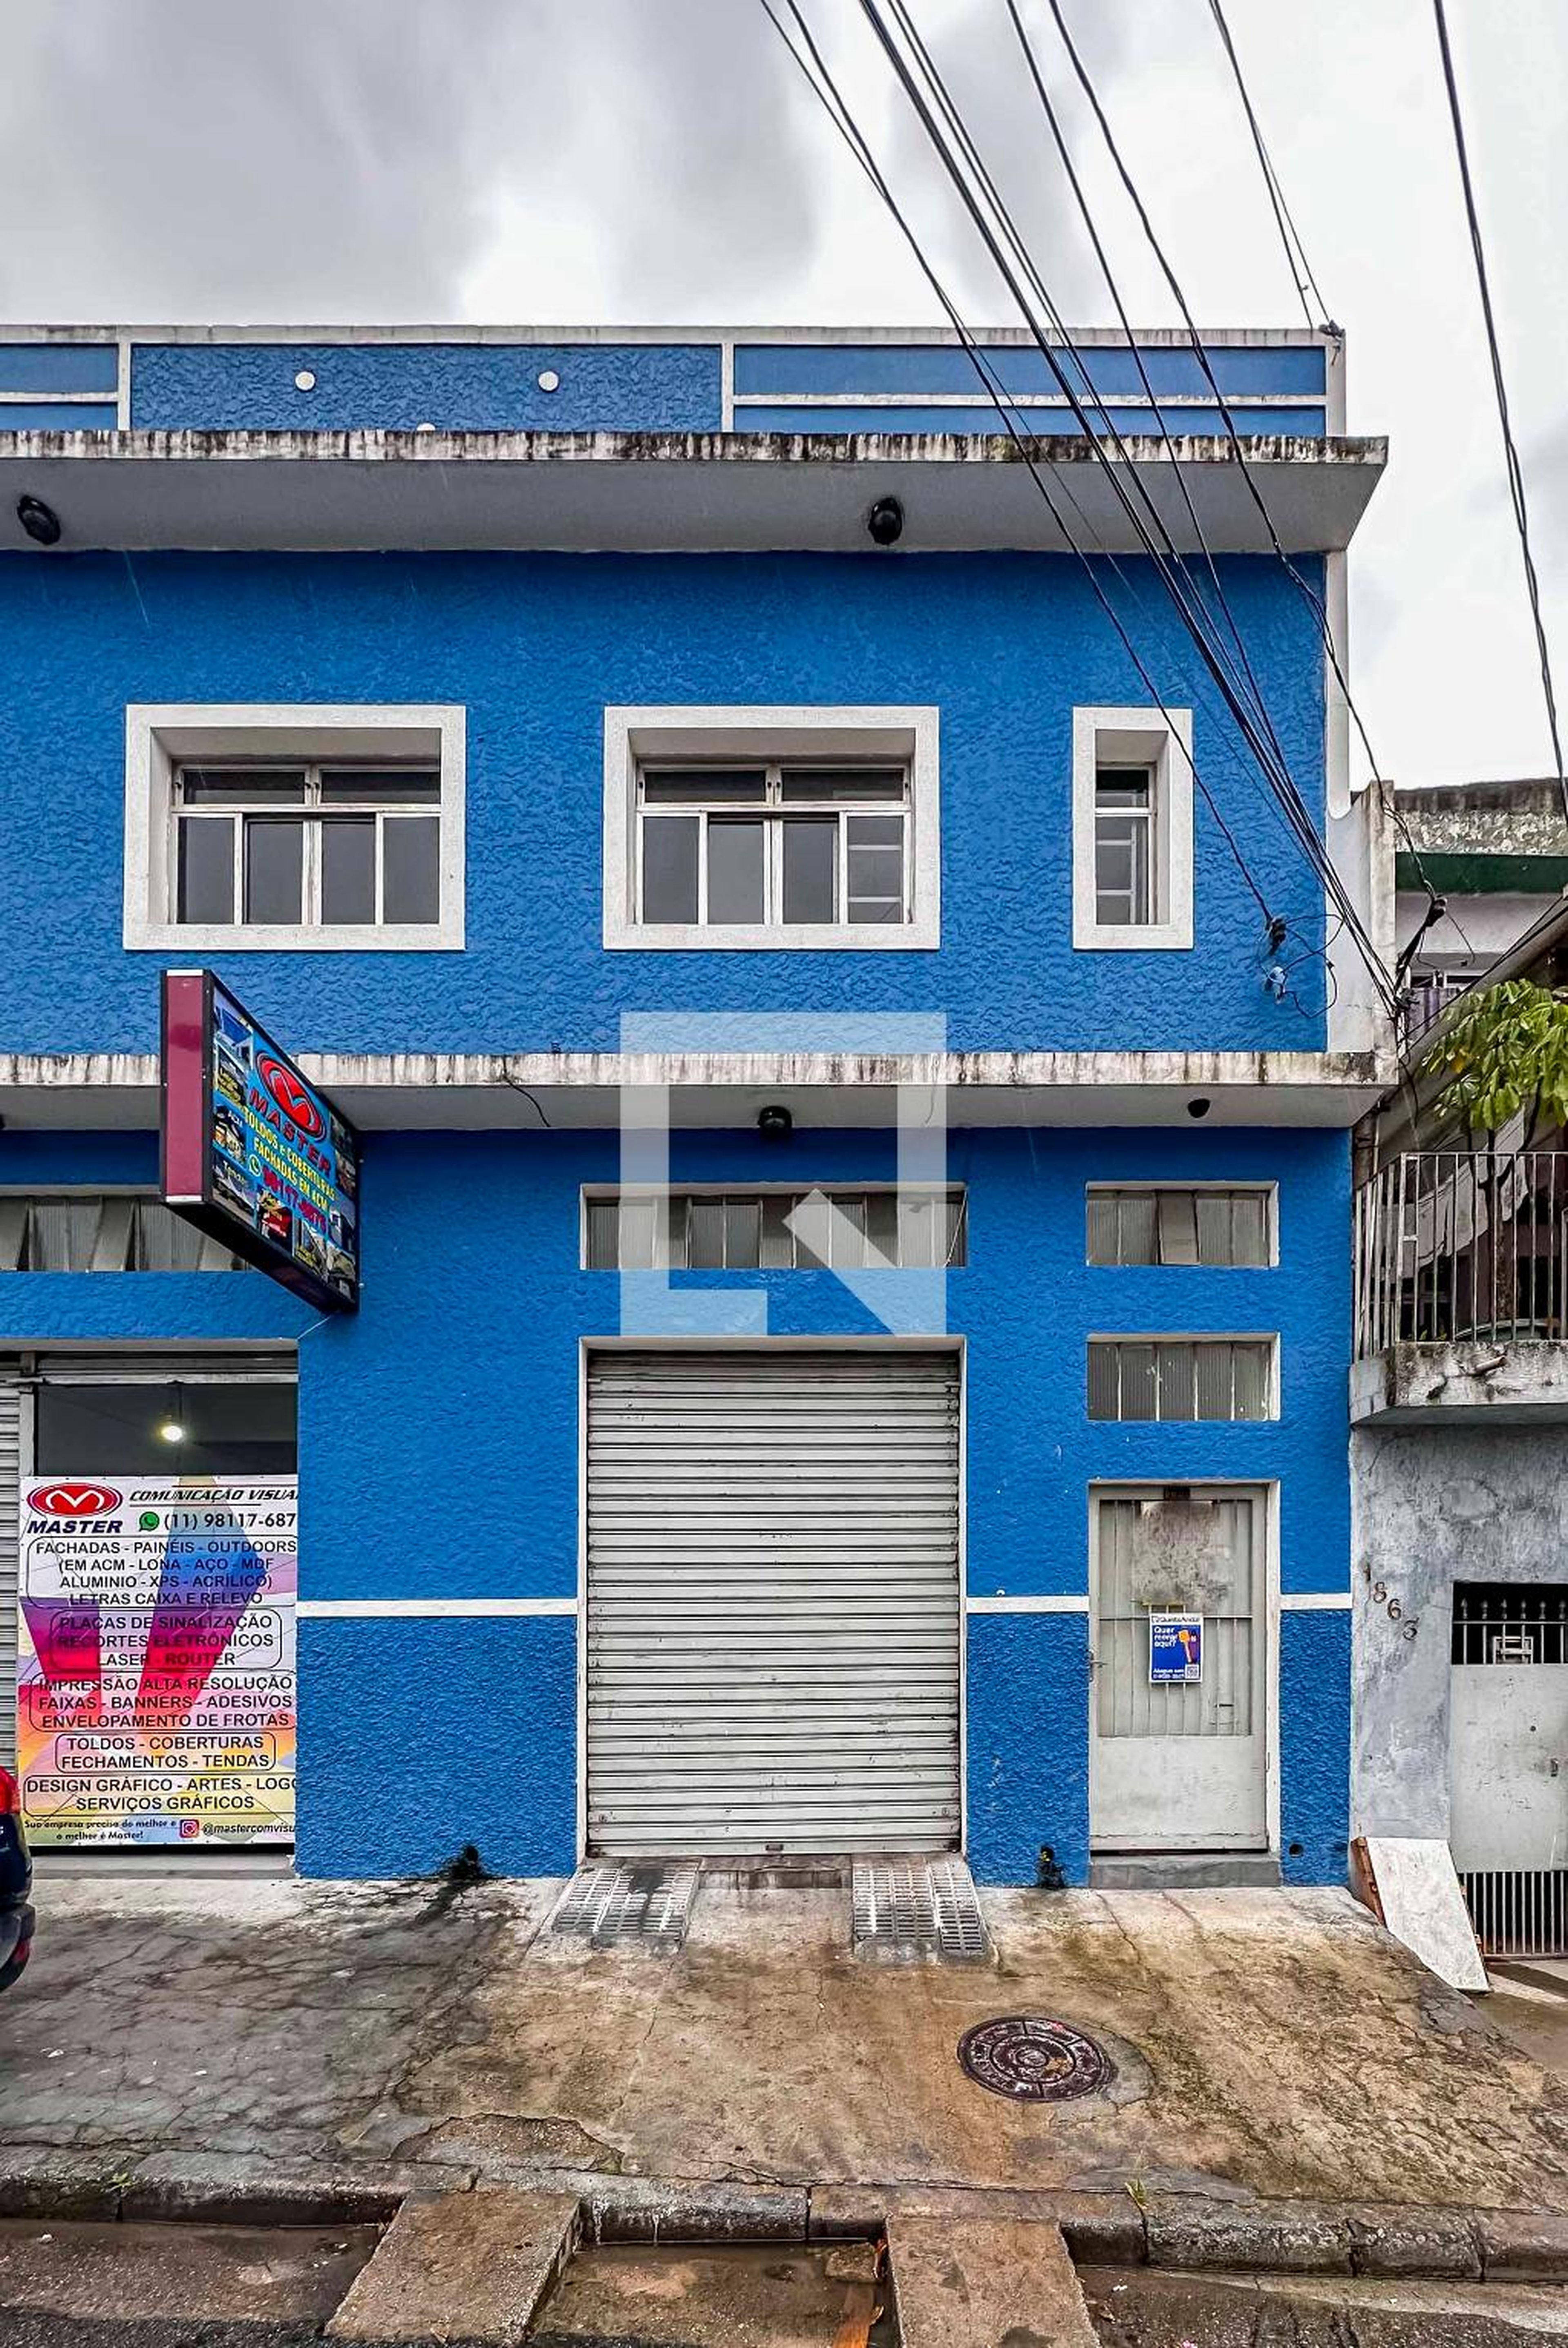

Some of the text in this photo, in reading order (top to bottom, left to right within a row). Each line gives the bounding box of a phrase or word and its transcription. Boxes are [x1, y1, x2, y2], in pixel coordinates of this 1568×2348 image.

[249, 1088, 330, 1176] MASTER
[242, 1104, 278, 1149] TOLDOS
[287, 1147, 335, 1201] COBERTURAS
[254, 1137, 297, 1186] FACHADAS
[129, 1488, 297, 1503] COMUNICAÇÃO VISUA
[27, 1520, 123, 1534] MASTER
[165, 1514, 198, 1530] (11)
[36, 1542, 121, 1554] FACHADAS
[134, 1539, 195, 1553] PAINÉIS
[207, 1541, 297, 1553] OUTDOORS
[59, 1559, 87, 1574] (EM
[91, 1559, 125, 1571] ACM
[139, 1559, 181, 1571] LONA
[194, 1558, 228, 1572] AÇO
[241, 1558, 274, 1570] MDF
[60, 1575, 137, 1588] ALUMINIO
[149, 1575, 180, 1588] XPS
[193, 1574, 272, 1590] ACRÍLICO)
[70, 1592, 263, 1605] LETRAS CAIXA E RELEVO
[60, 1612, 272, 1631] PLACAS DE SINALIZAÇÃO
[58, 1631, 274, 1648] RECORTES ELETRÔNICOS
[98, 1653, 150, 1666] LASER
[165, 1652, 236, 1666] ROUTER
[40, 1674, 292, 1692] IMPRESSÃO ALTA RESOLUÇÃO
[39, 1697, 97, 1710] FAIXAS
[111, 1696, 193, 1709] BANNERS
[206, 1695, 292, 1708] ADESIVOS
[42, 1713, 289, 1728] ENVELOPAMENTO DE FROTAS
[67, 1737, 136, 1750] TOLDOS
[149, 1736, 264, 1749] COBERTURAS
[62, 1755, 188, 1769] FECHAMENTOS
[202, 1755, 270, 1767] TENDAS
[27, 1779, 91, 1793] DESIGN
[96, 1777, 173, 1791] GRÁFICO
[187, 1778, 242, 1791] ARTES
[76, 1793, 255, 1812] SERVIÇOS GRÁFICOS
[24, 1820, 42, 1828] Sua
[44, 1822, 84, 1830] empresa
[86, 1820, 119, 1830] precisa
[136, 1819, 168, 1828] melhor
[65, 1831, 97, 1840] melhor
[108, 1831, 144, 1840] Master!
